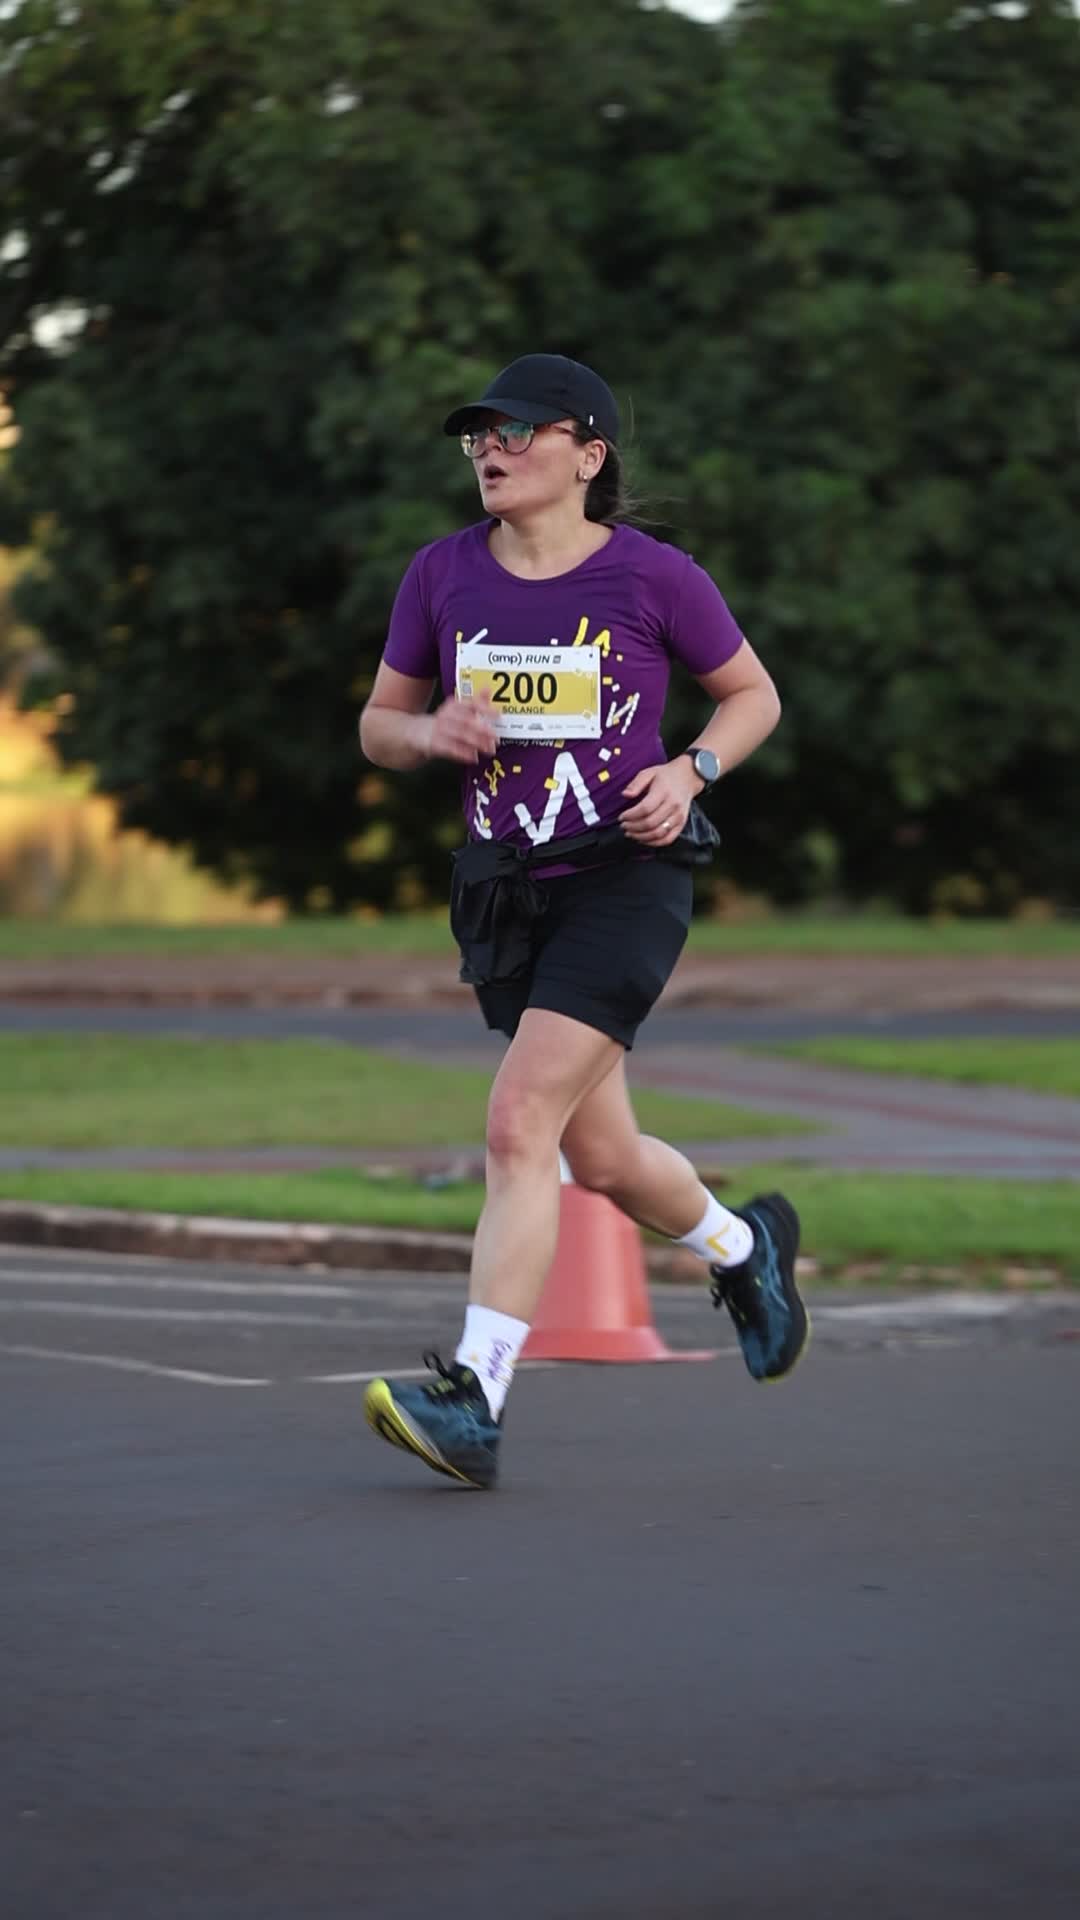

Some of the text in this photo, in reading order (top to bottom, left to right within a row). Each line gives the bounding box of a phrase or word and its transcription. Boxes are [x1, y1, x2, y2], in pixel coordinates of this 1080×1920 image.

[488, 651, 551, 666] (amp) RUN
[491, 671, 558, 704] 200
[502, 705, 546, 714] SOLANGE
